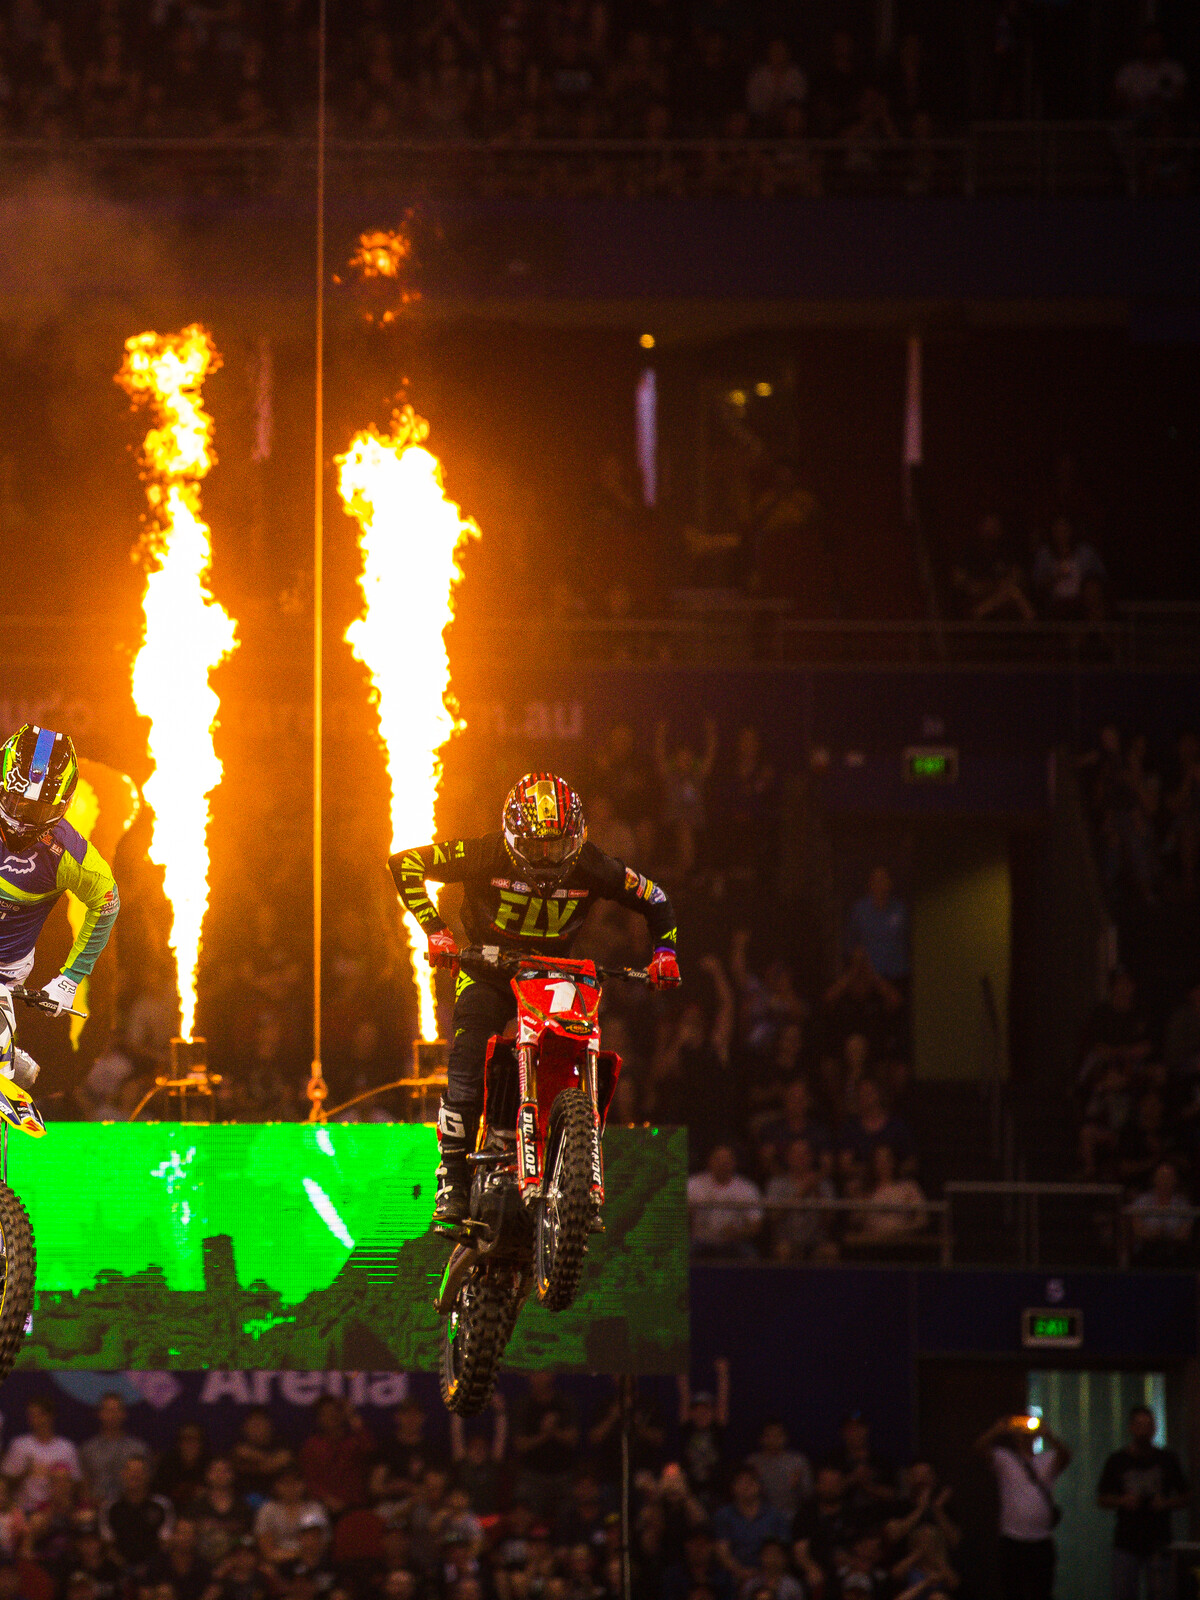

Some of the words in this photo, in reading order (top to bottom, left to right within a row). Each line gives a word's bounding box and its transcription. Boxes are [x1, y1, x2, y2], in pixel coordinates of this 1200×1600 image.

[494, 889, 579, 937] FLY
[544, 981, 576, 1014] 1
[523, 1112, 537, 1176] DULOP
[201, 1370, 409, 1407] Arena
